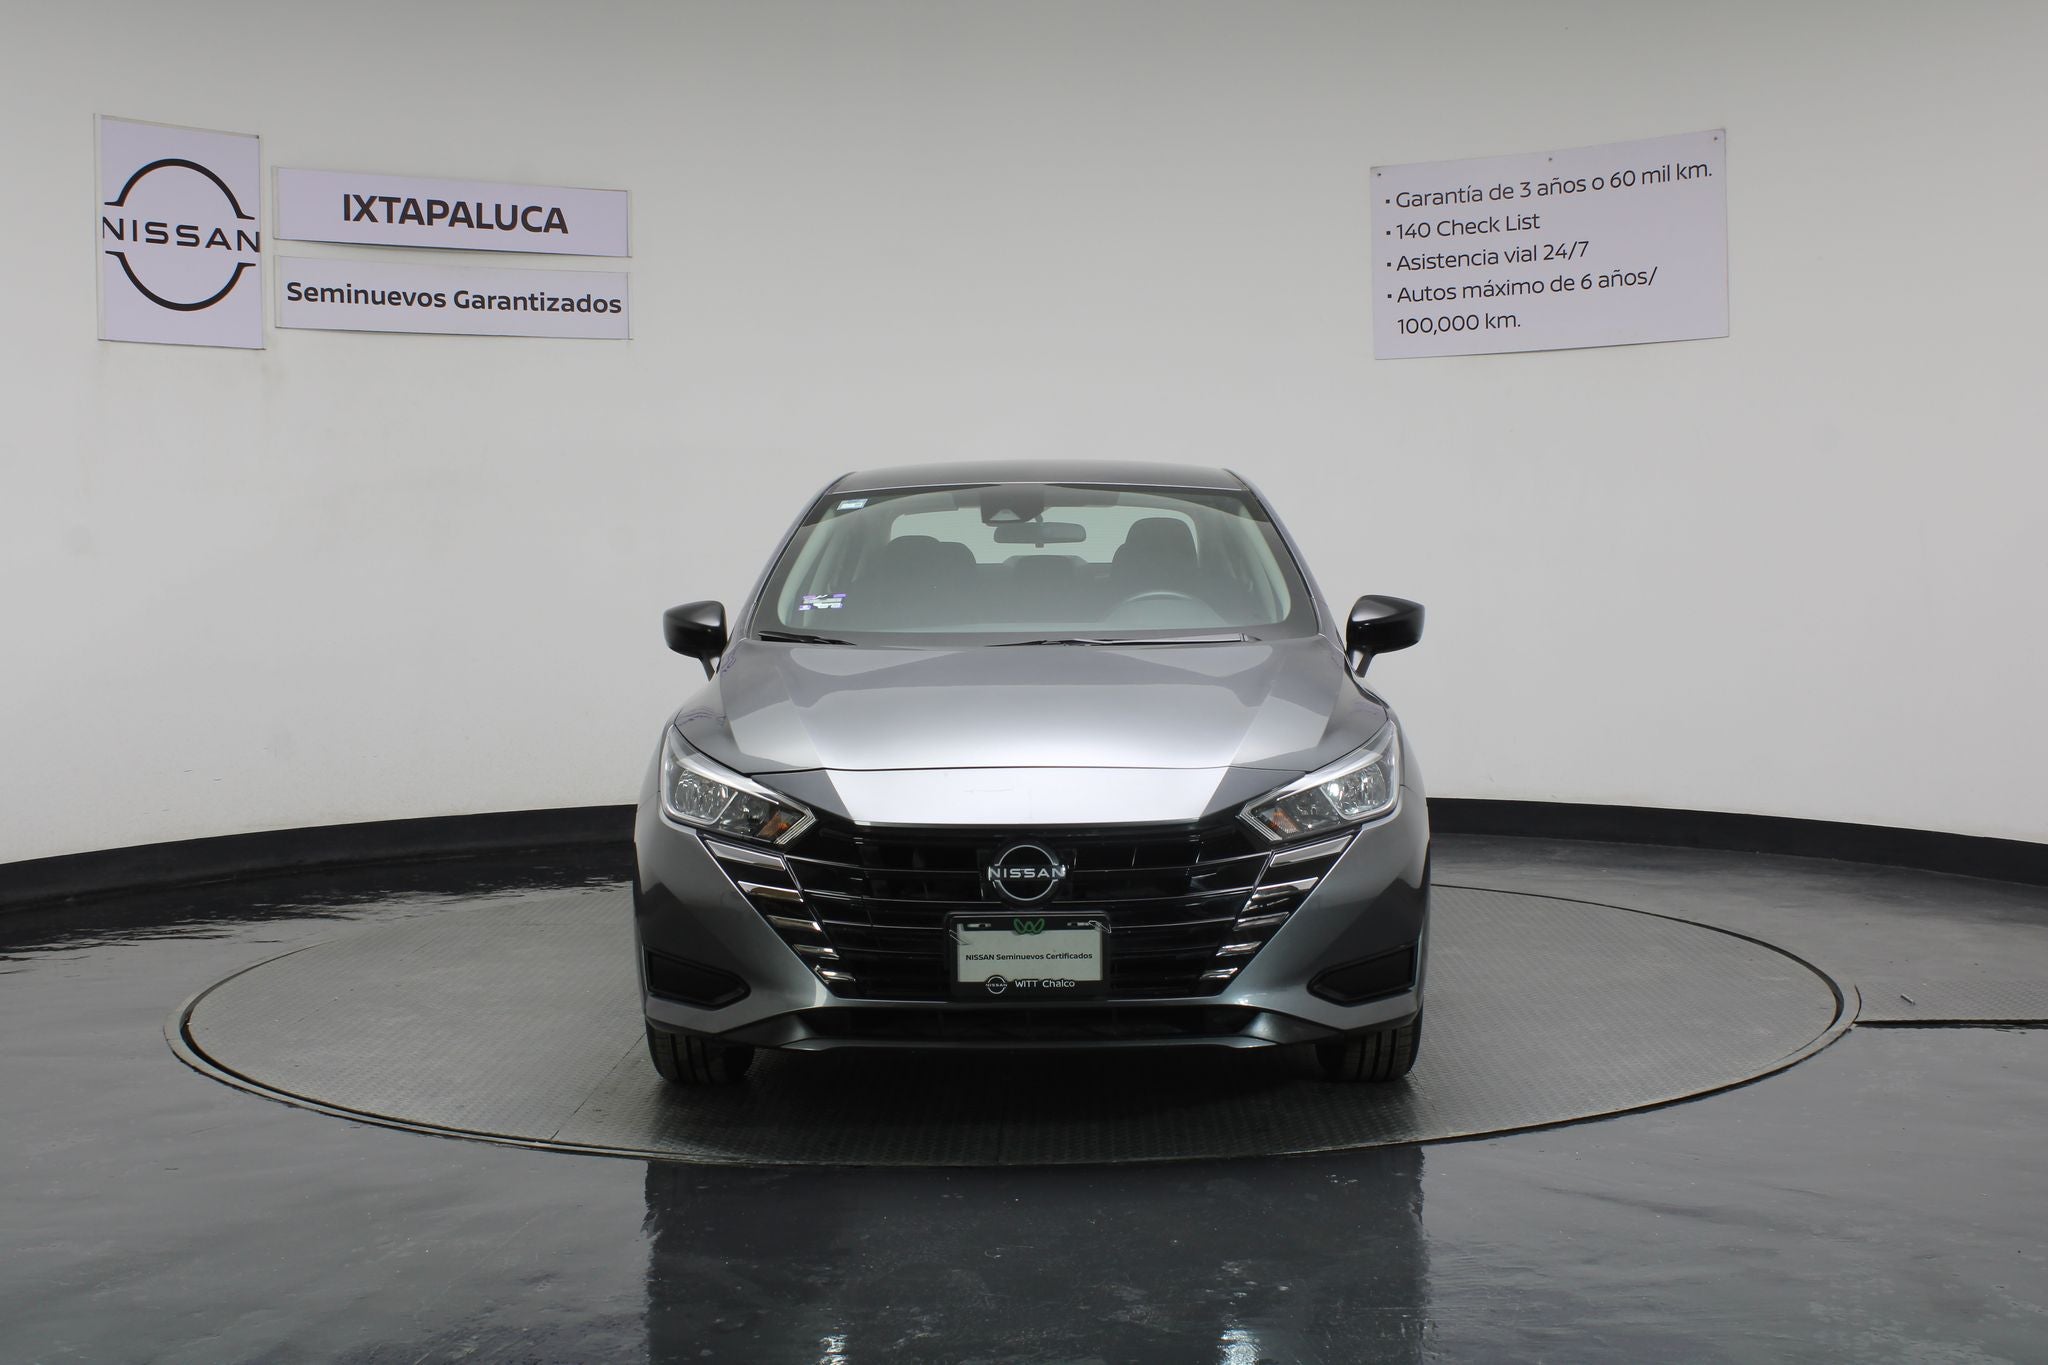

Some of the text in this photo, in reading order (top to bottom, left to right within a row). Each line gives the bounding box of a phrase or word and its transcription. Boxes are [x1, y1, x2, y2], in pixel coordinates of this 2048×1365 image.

[1396, 162, 1713, 209] Garantía de 3 años o 60 mil km.
[343, 193, 569, 235] IXTAPALUCA
[1396, 213, 1541, 240] 140 Check List
[102, 215, 260, 254] NISSAN
[1396, 240, 1590, 272] Asistencia vial 24/7
[286, 281, 622, 314] Seminuevos Garantizados
[1396, 265, 1658, 304] Autos máximo de 6 años/
[1397, 312, 1521, 336] 100,000 km.
[988, 867, 1066, 880] NISSAN
[965, 951, 1093, 961] NISSAN Seminuevos Certificados
[1014, 979, 1038, 988] WITT
[1042, 978, 1076, 988] Chalco
